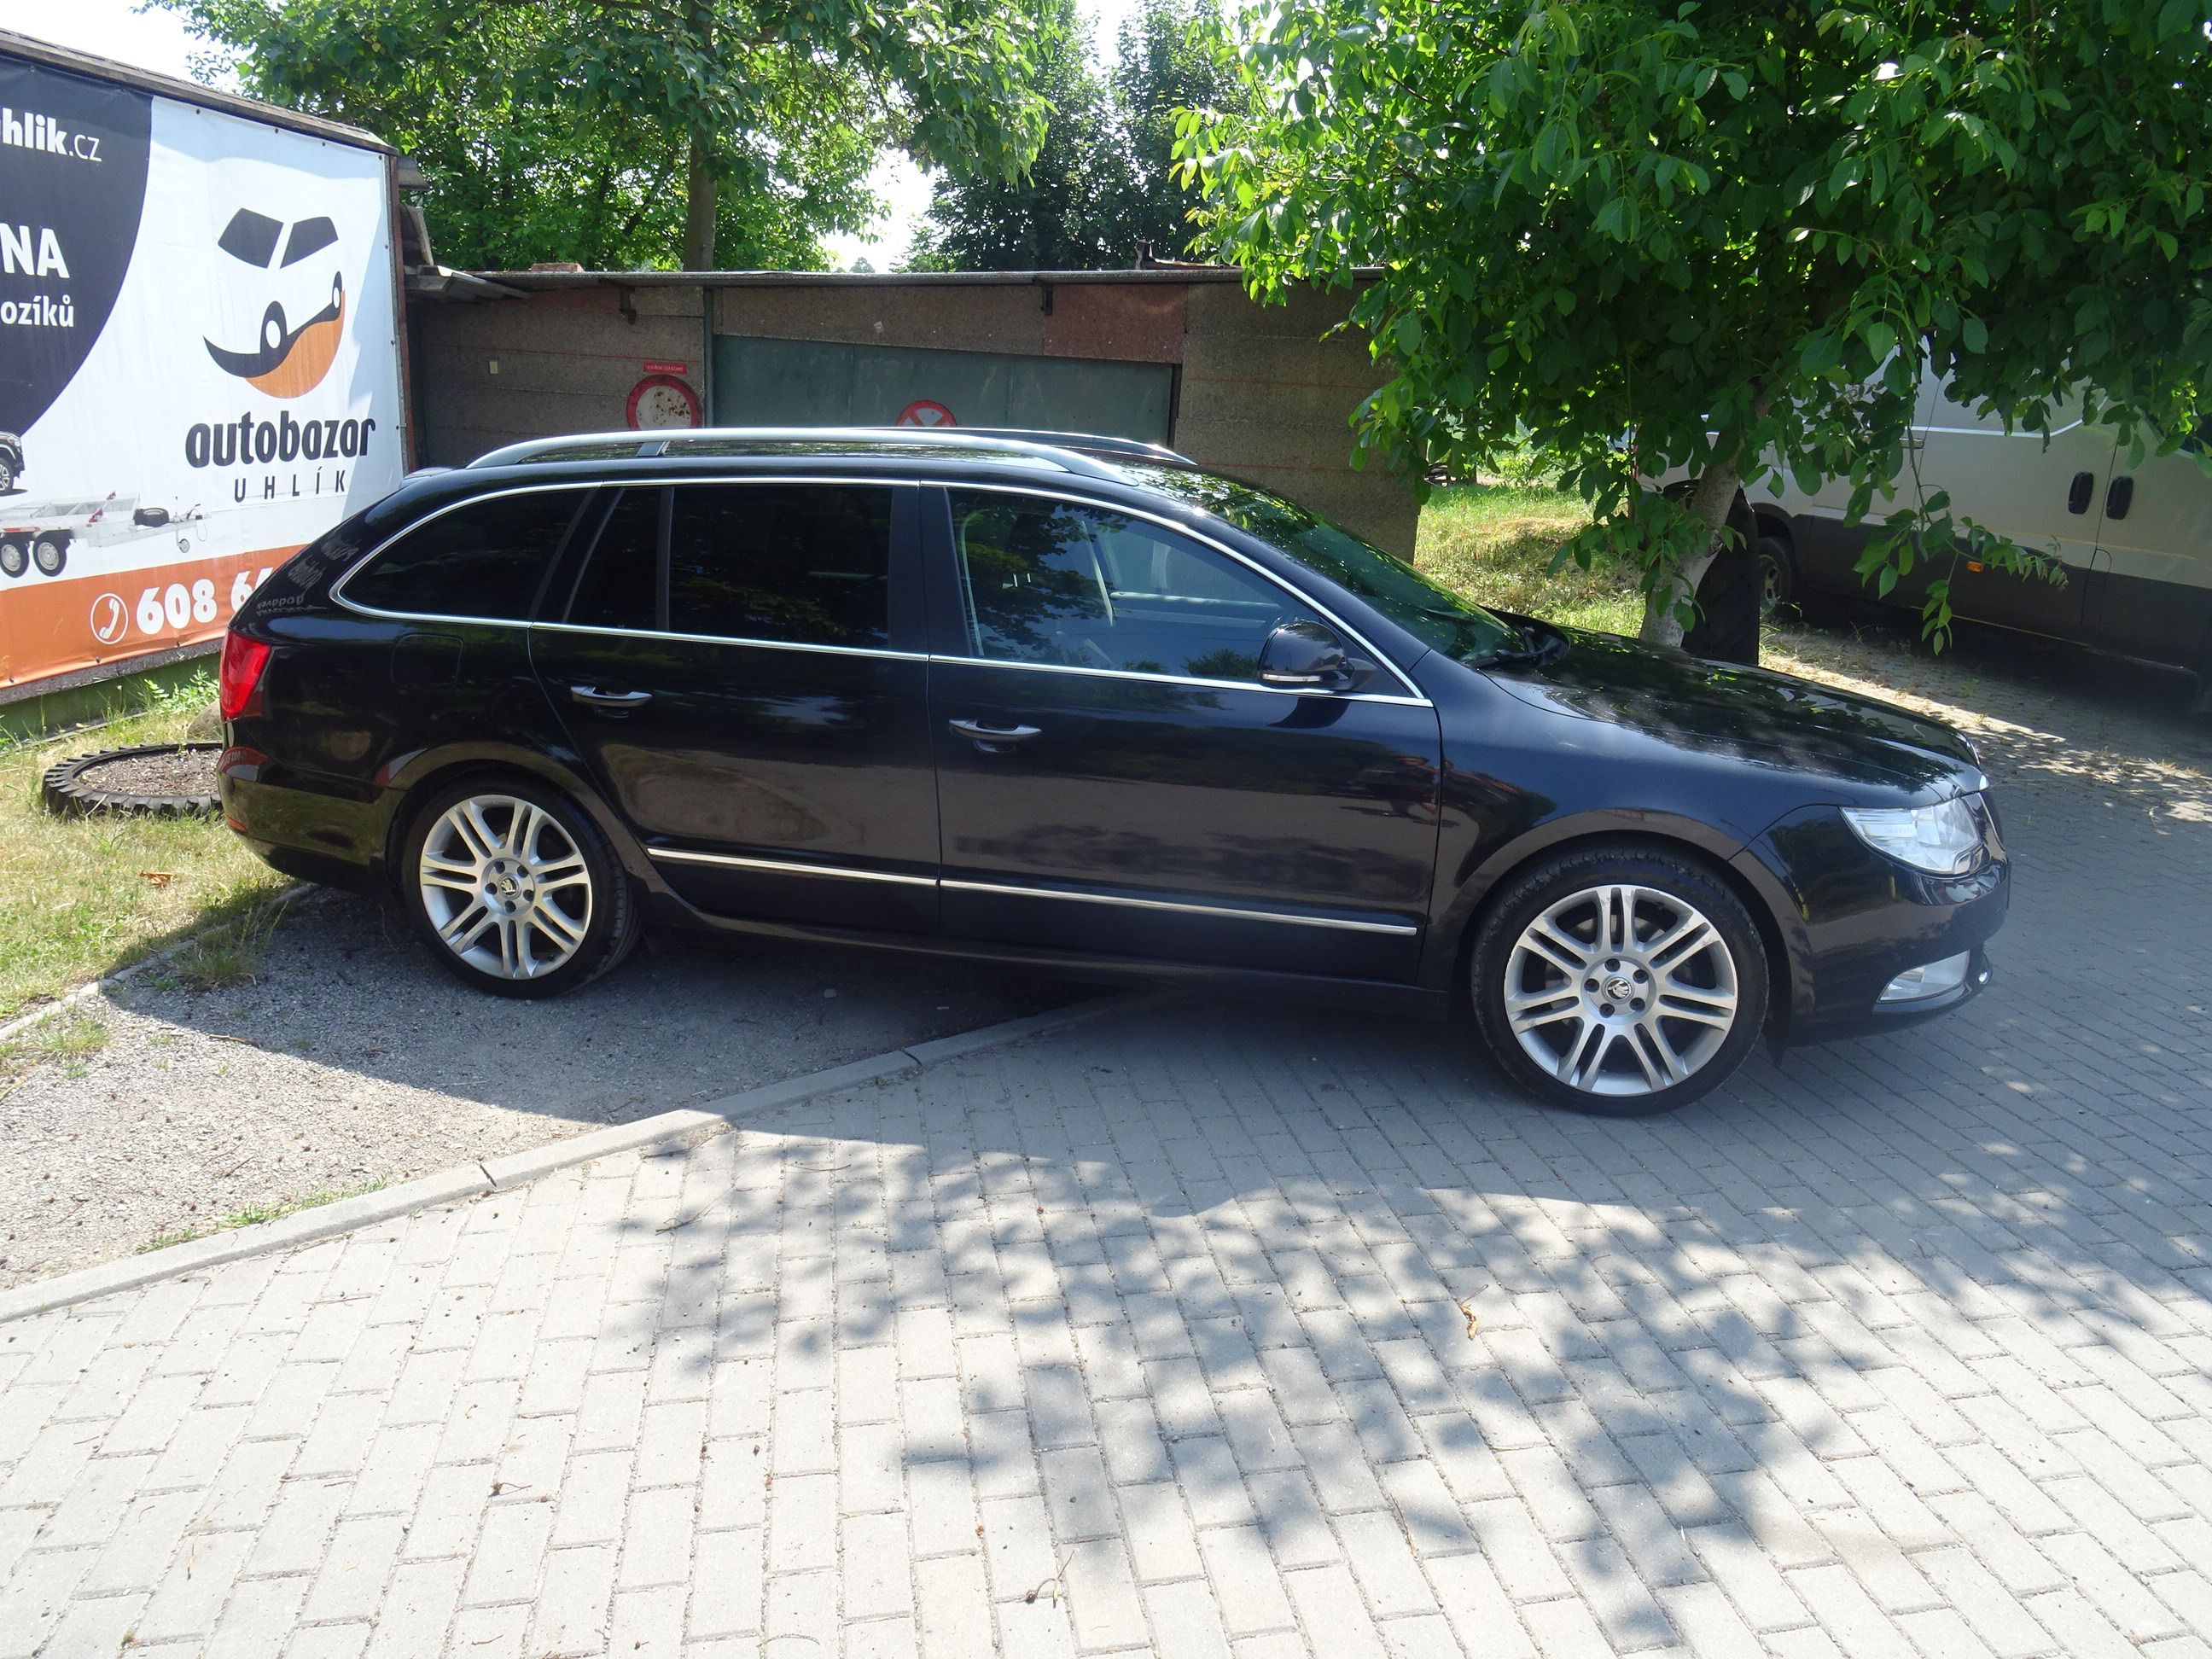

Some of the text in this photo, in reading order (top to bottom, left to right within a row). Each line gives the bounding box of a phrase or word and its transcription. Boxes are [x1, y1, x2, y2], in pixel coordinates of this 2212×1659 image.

[185, 410, 376, 469] autobazar
[234, 466, 346, 504] UHLÍK
[136, 579, 218, 635] 608
